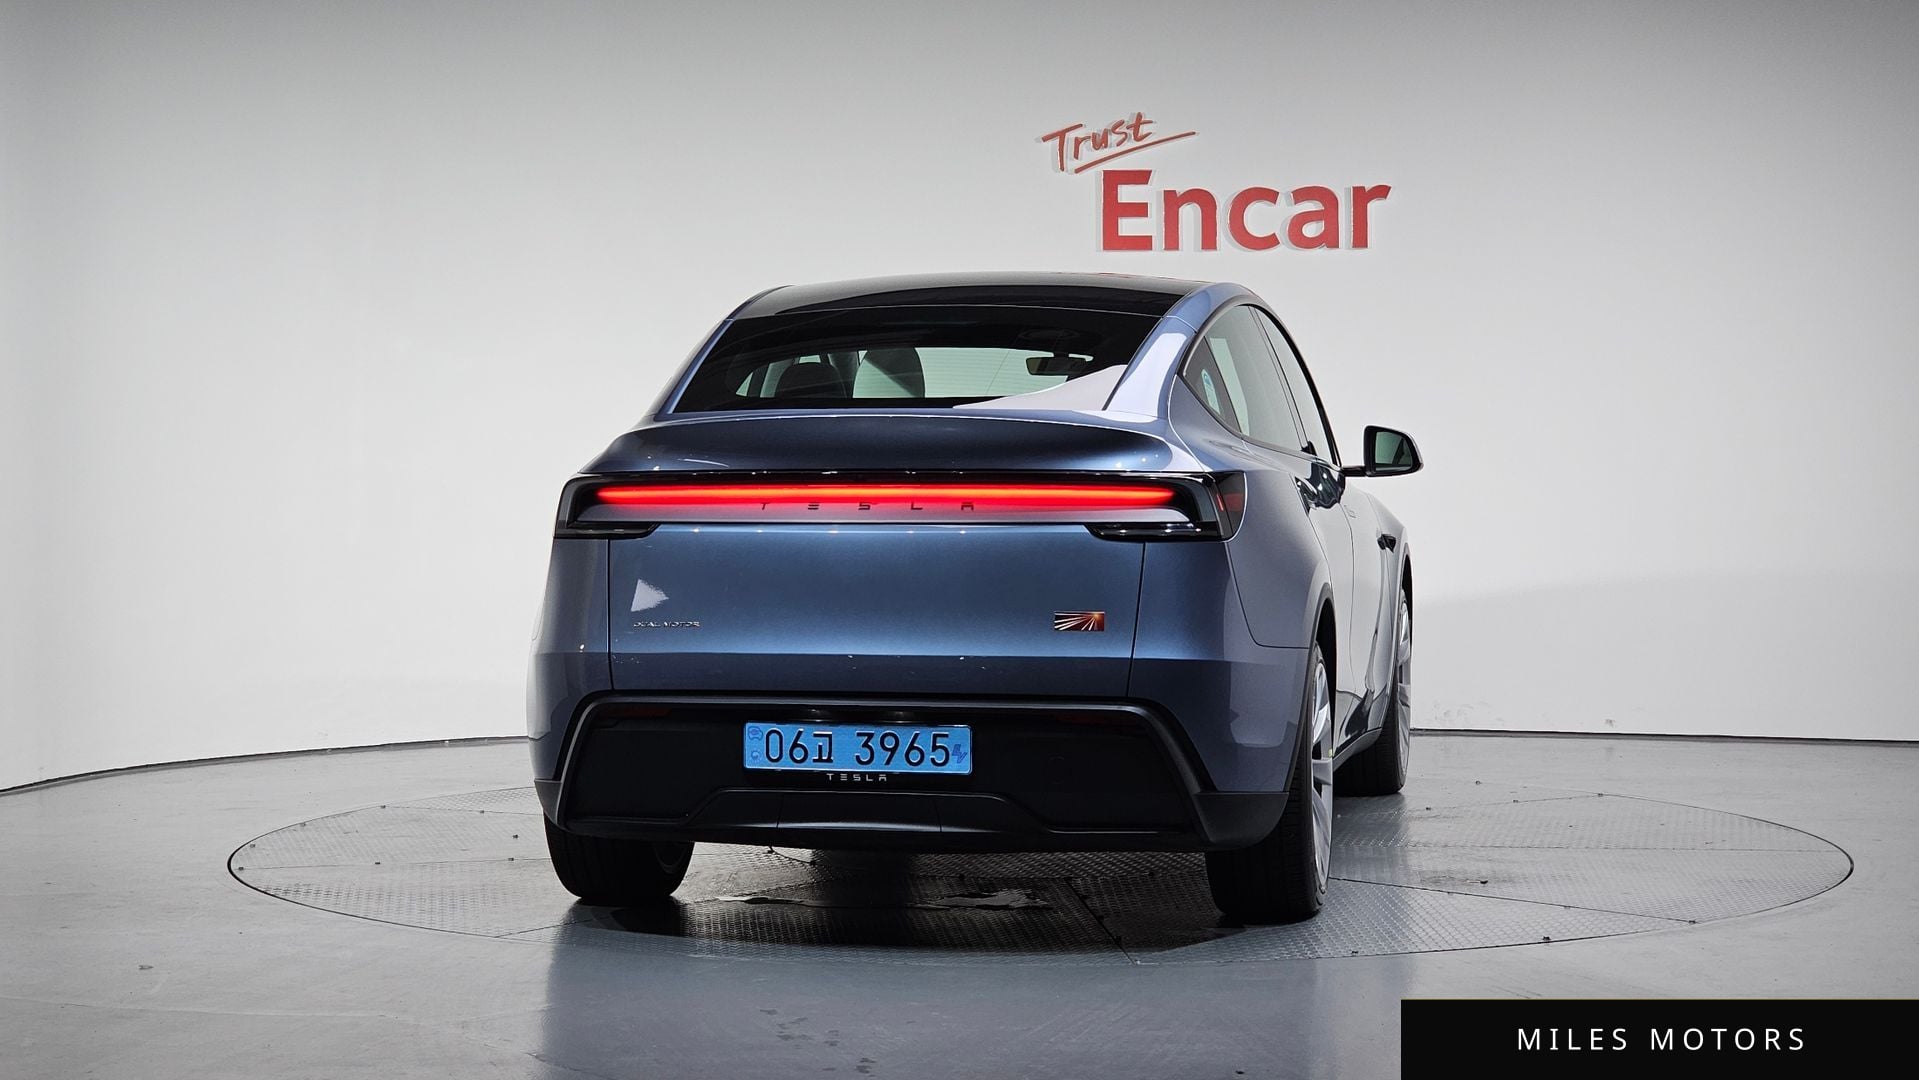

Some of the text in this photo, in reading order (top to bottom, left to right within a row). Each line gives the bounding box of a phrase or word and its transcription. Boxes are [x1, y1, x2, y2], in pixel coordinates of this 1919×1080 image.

[1041, 111, 1154, 172] Trust
[1101, 168, 1392, 251] Encar
[761, 501, 975, 511] TESLA
[663, 620, 701, 628] MOTOR
[765, 728, 951, 768] 06고 3965
[826, 772, 888, 782] TESLA
